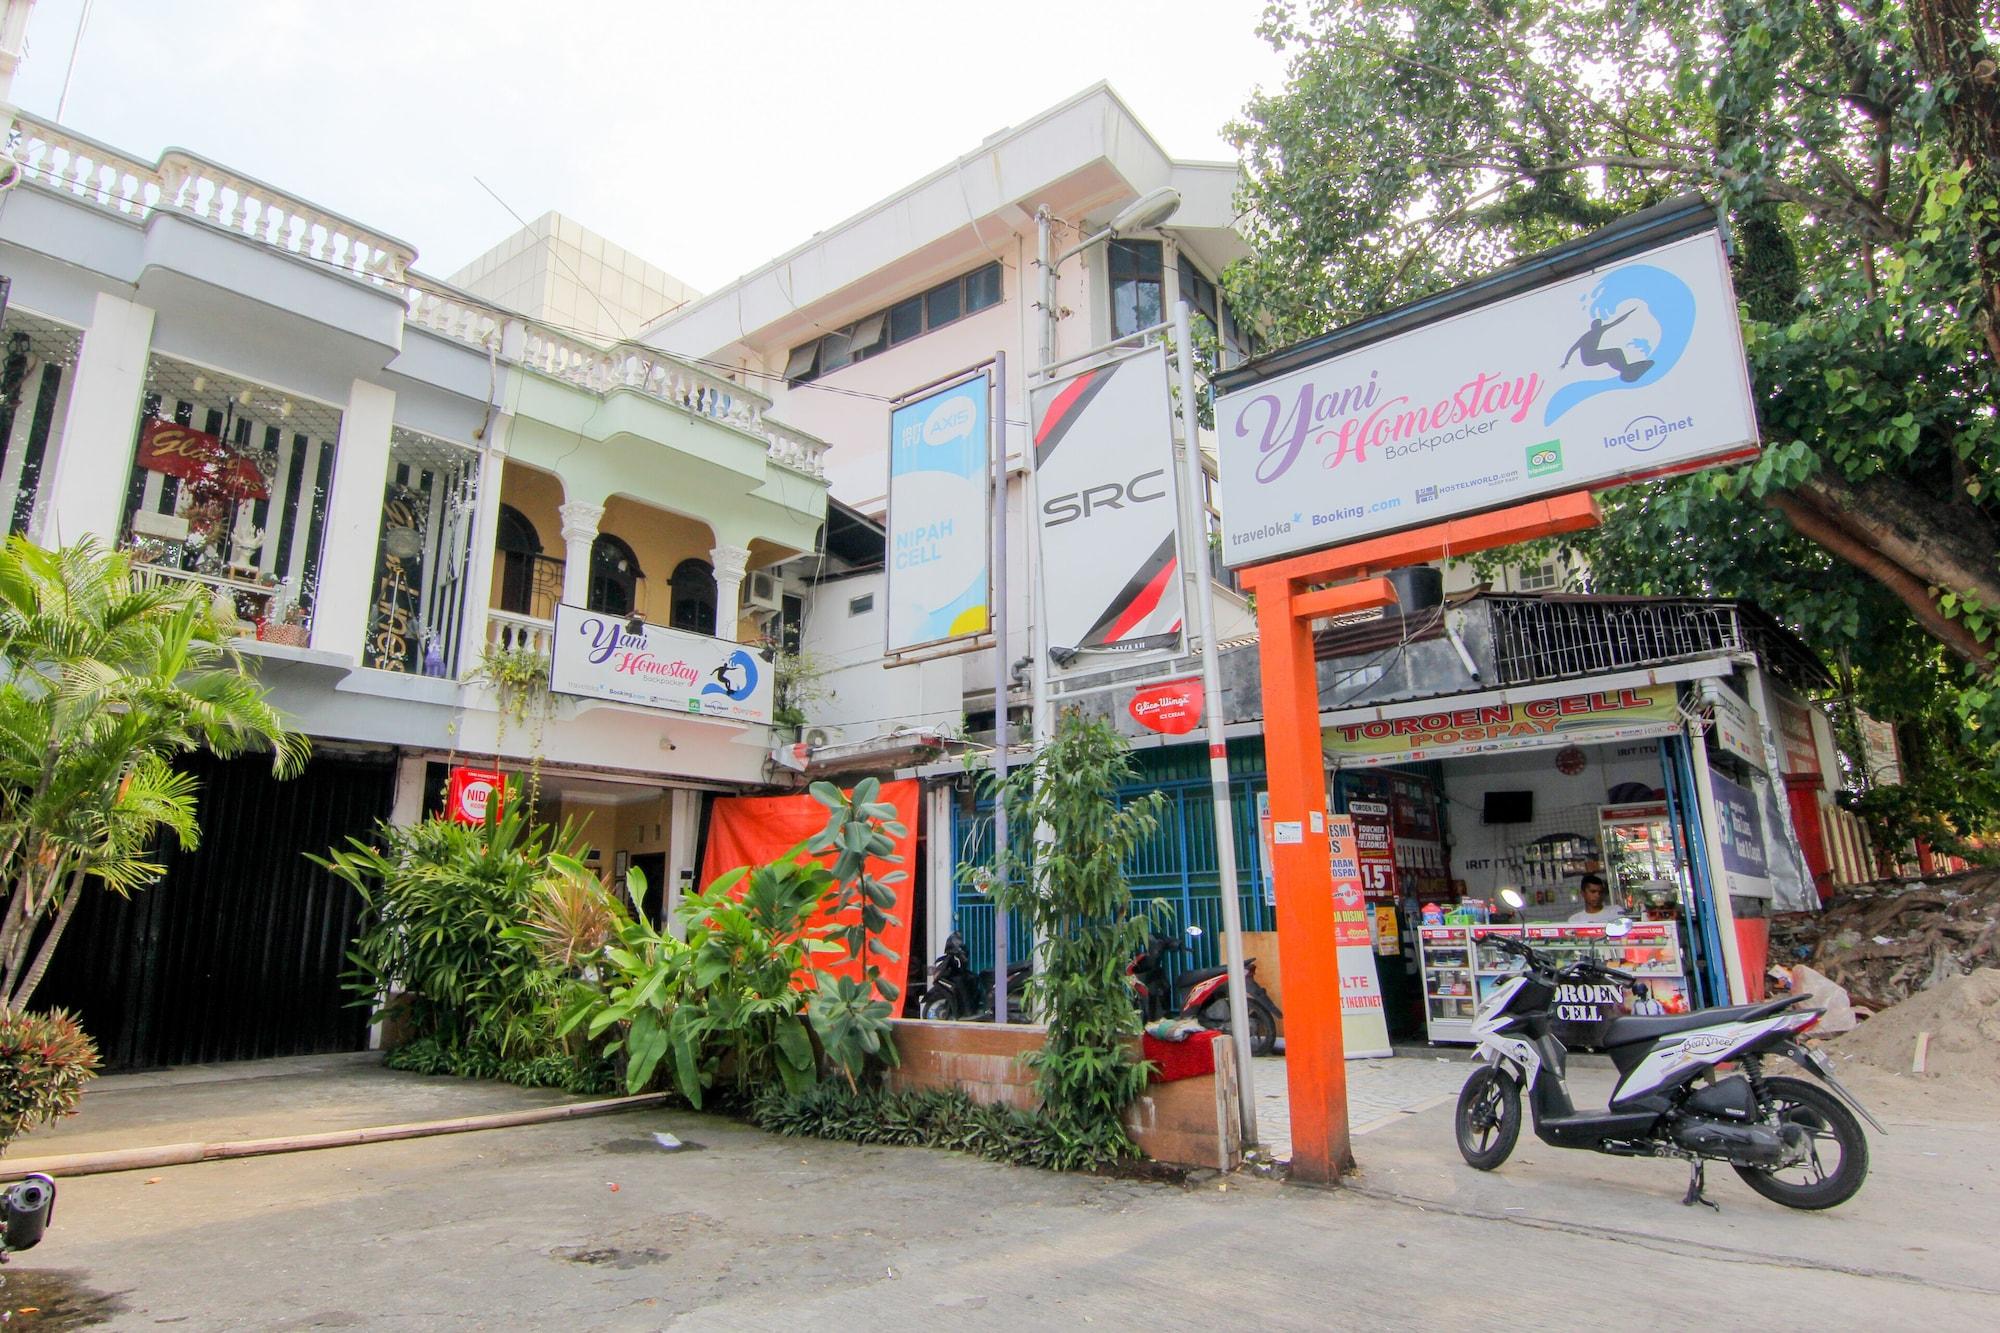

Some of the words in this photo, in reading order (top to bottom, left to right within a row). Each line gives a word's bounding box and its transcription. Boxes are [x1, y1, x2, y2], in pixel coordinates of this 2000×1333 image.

[930, 409, 969, 435] AXIS
[1236, 370, 1382, 484] Yani
[1315, 371, 1545, 470] Homestay
[1645, 416, 1694, 440] planet
[1385, 418, 1499, 461] Backpacker
[1439, 470, 1518, 494] HOSTELWORLD.com
[1043, 469, 1166, 527] SRC
[1312, 506, 1364, 526] Booking
[1367, 497, 1401, 513] .com
[896, 518, 953, 549] NIPAH
[1232, 521, 1291, 546] traveloka
[895, 544, 942, 570] CELL
[580, 618, 648, 664] Yani
[613, 652, 699, 687] Homestay
[643, 674, 685, 687] Backpacker
[1135, 701, 1160, 715] Glico
[1159, 697, 1190, 707] Wings
[1337, 704, 1512, 742] TOROEN
[1525, 688, 1652, 719] CELL
[1410, 717, 1562, 747] POSPAY
[1639, 745, 1657, 755] ITU
[1352, 803, 1371, 812] TOROEN
[1372, 805, 1385, 813] CELL
[1328, 824, 1350, 837] ESMI
[1359, 825, 1385, 833] VOUCHER
[1359, 833, 1385, 841] INTERNET
[1330, 841, 1341, 853] S
[1330, 859, 1354, 868] ARAN
[1332, 868, 1357, 877] OSPAY
[1465, 859, 1490, 870] IRIT
[1342, 976, 1368, 988] LTE
[1552, 984, 1623, 1003] OROEN
[1557, 1004, 1602, 1021] CELL
